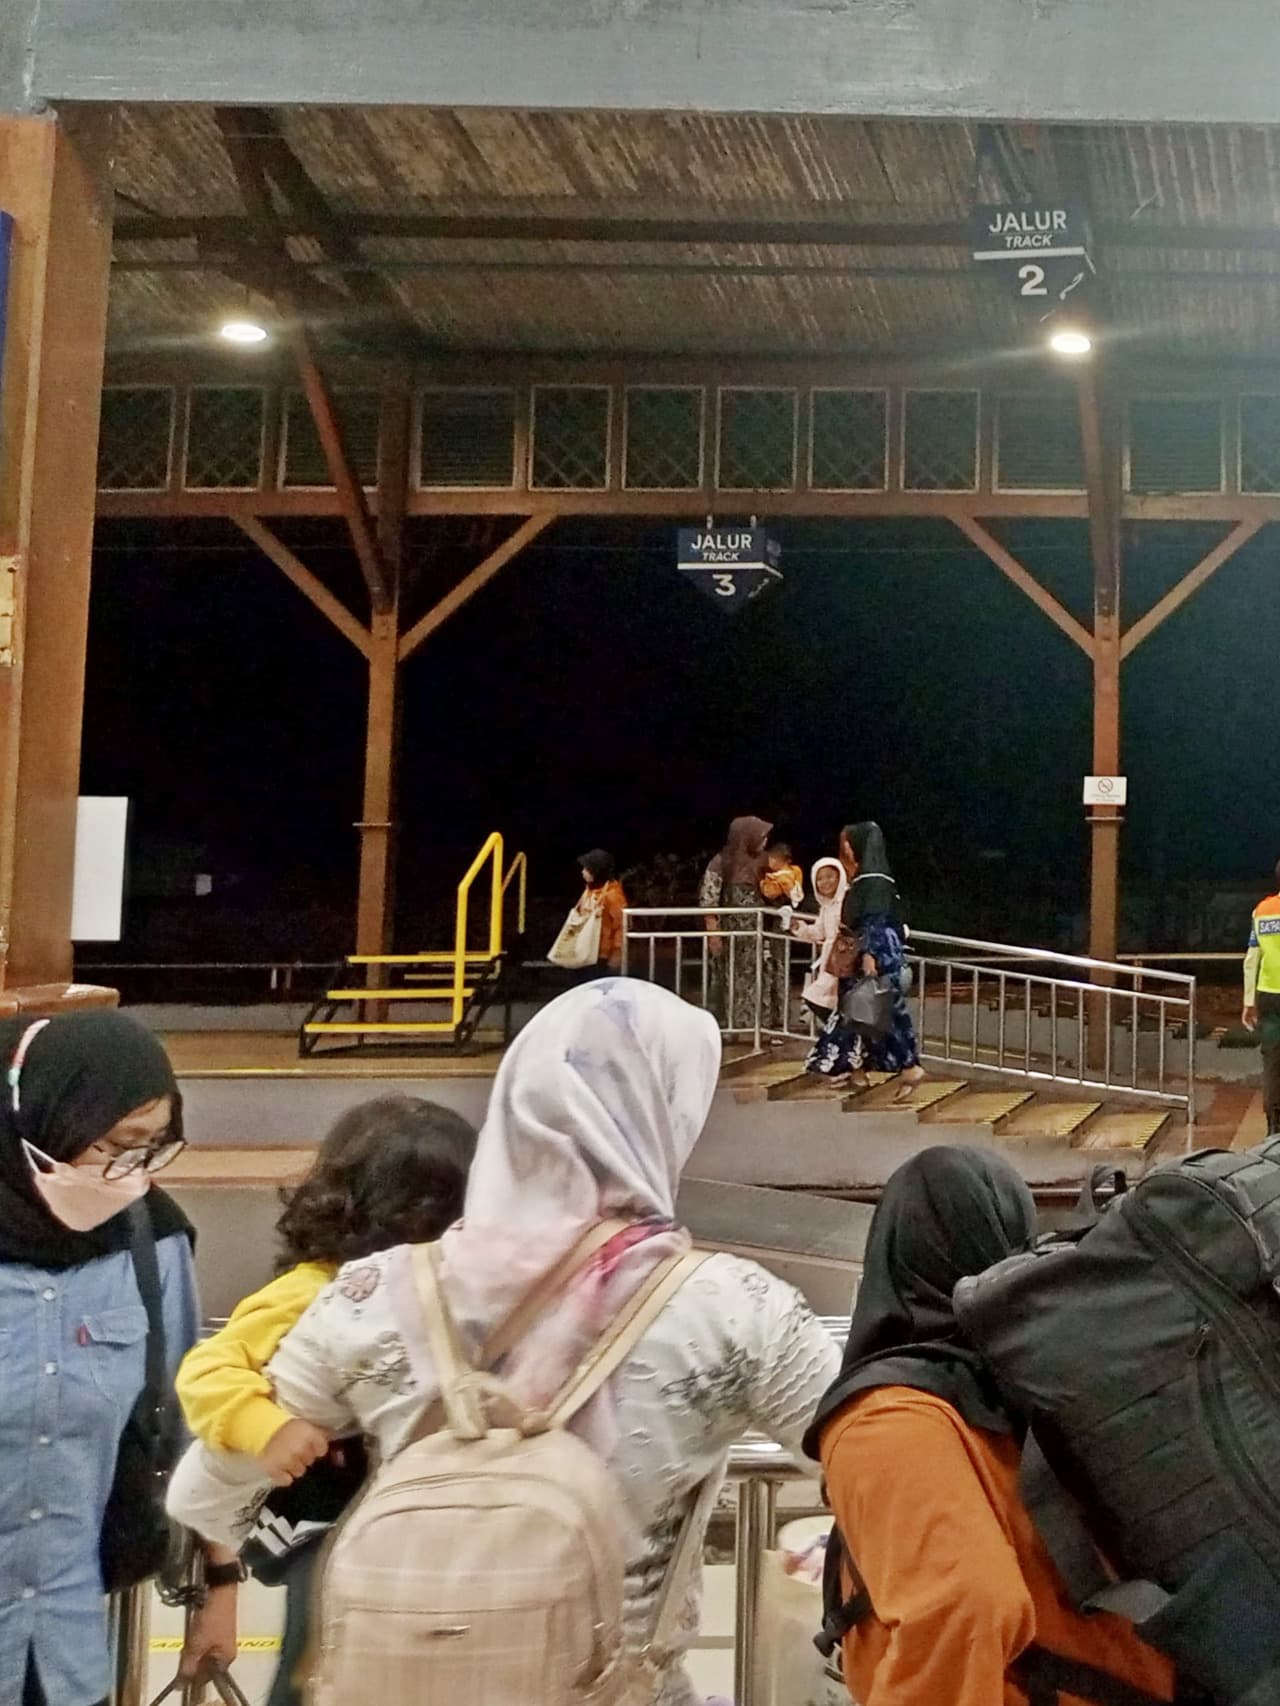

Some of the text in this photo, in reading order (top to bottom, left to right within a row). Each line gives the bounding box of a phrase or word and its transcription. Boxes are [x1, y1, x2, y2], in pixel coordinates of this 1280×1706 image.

[989, 210, 1067, 233] JALUR
[1005, 234, 1053, 249] TRACK
[1018, 264, 1048, 296] 2
[691, 533, 752, 550] JALUR
[702, 551, 740, 561] TRACK
[712, 573, 737, 597] 3
